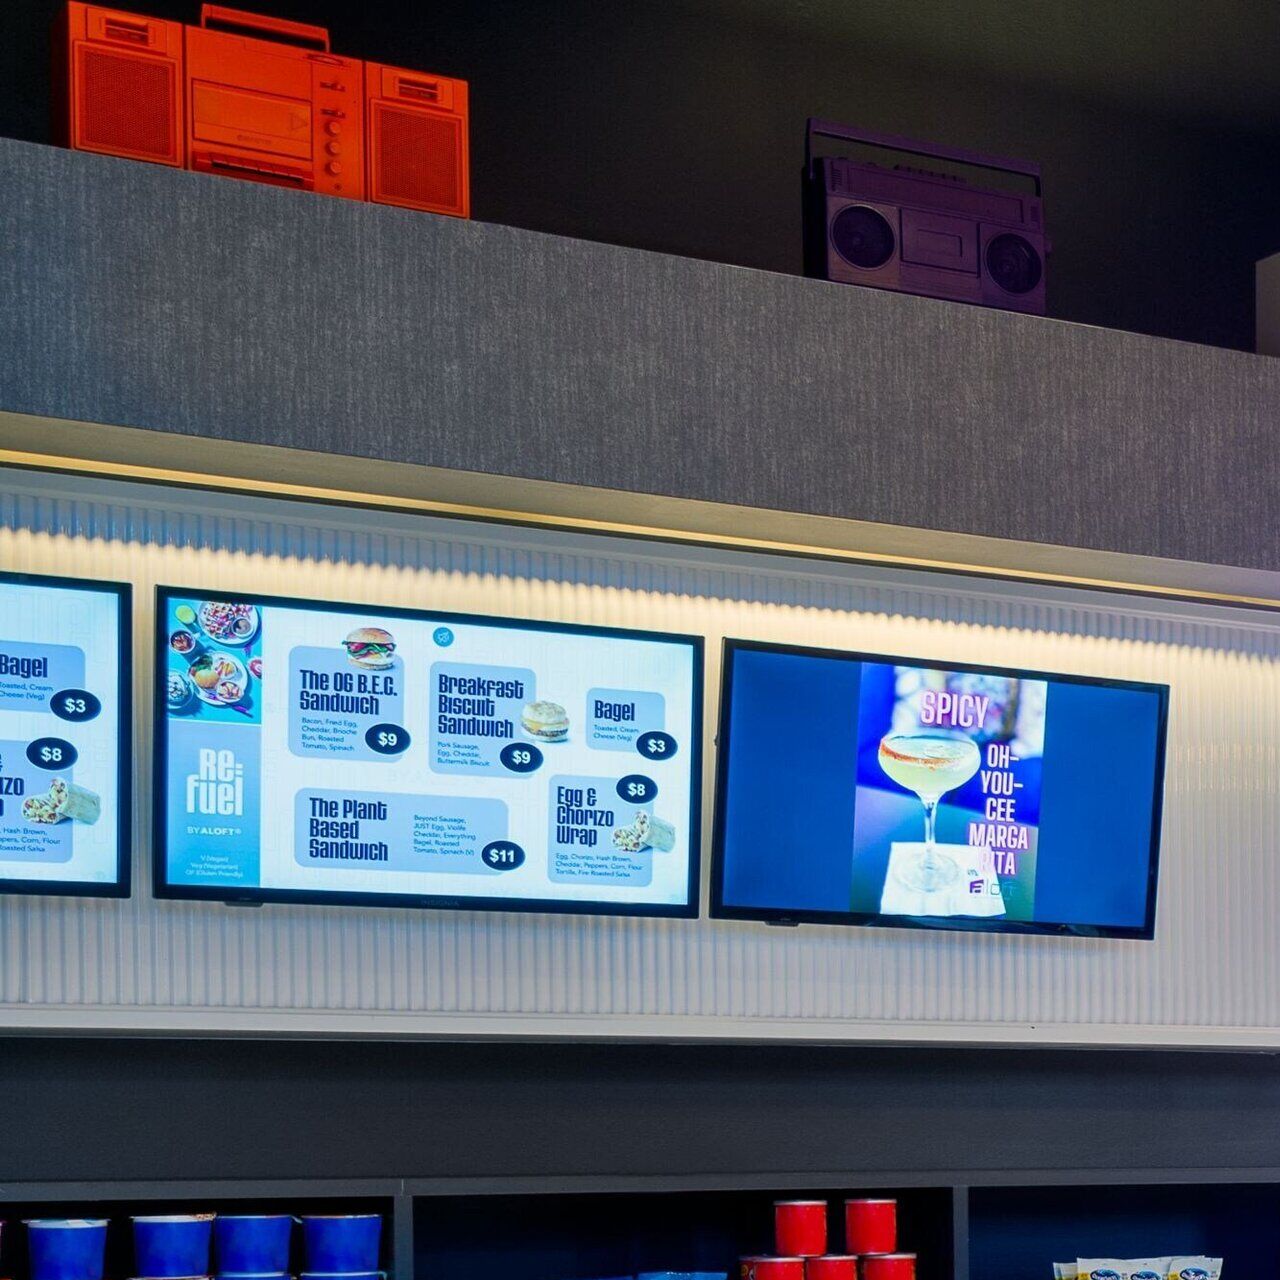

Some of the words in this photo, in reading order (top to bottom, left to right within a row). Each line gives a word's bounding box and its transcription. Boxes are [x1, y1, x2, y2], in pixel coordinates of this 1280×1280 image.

[299, 669, 330, 691] The
[333, 672, 354, 692] OG
[357, 674, 398, 696] B.E.C.
[438, 674, 524, 699] Breakfast
[64, 698, 86, 713] $3
[299, 690, 379, 715] Sandwich
[438, 694, 495, 717] Biscuit
[594, 699, 635, 722] Bagel
[920, 690, 989, 729] SPICY
[438, 714, 513, 738] Sandwich
[378, 731, 397, 747] $9
[647, 738, 666, 753] $3
[41, 746, 62, 762] $8
[512, 750, 531, 765] $9
[986, 744, 1020, 769] OH-
[627, 782, 646, 797] $8
[981, 770, 1023, 795] YOU-
[186, 774, 243, 816] fuel
[557, 786, 583, 808] Egg
[587, 787, 597, 806] &
[309, 797, 339, 818] The
[343, 799, 387, 820] Plant
[557, 805, 614, 827] Chorizo
[985, 797, 1015, 823] CEE
[309, 818, 359, 839] Based
[556, 825, 597, 847] Wrap
[968, 823, 1029, 850] MARGA
[309, 838, 389, 861] Sandwich
[489, 848, 515, 863] $11
[979, 850, 1016, 876] RITA
